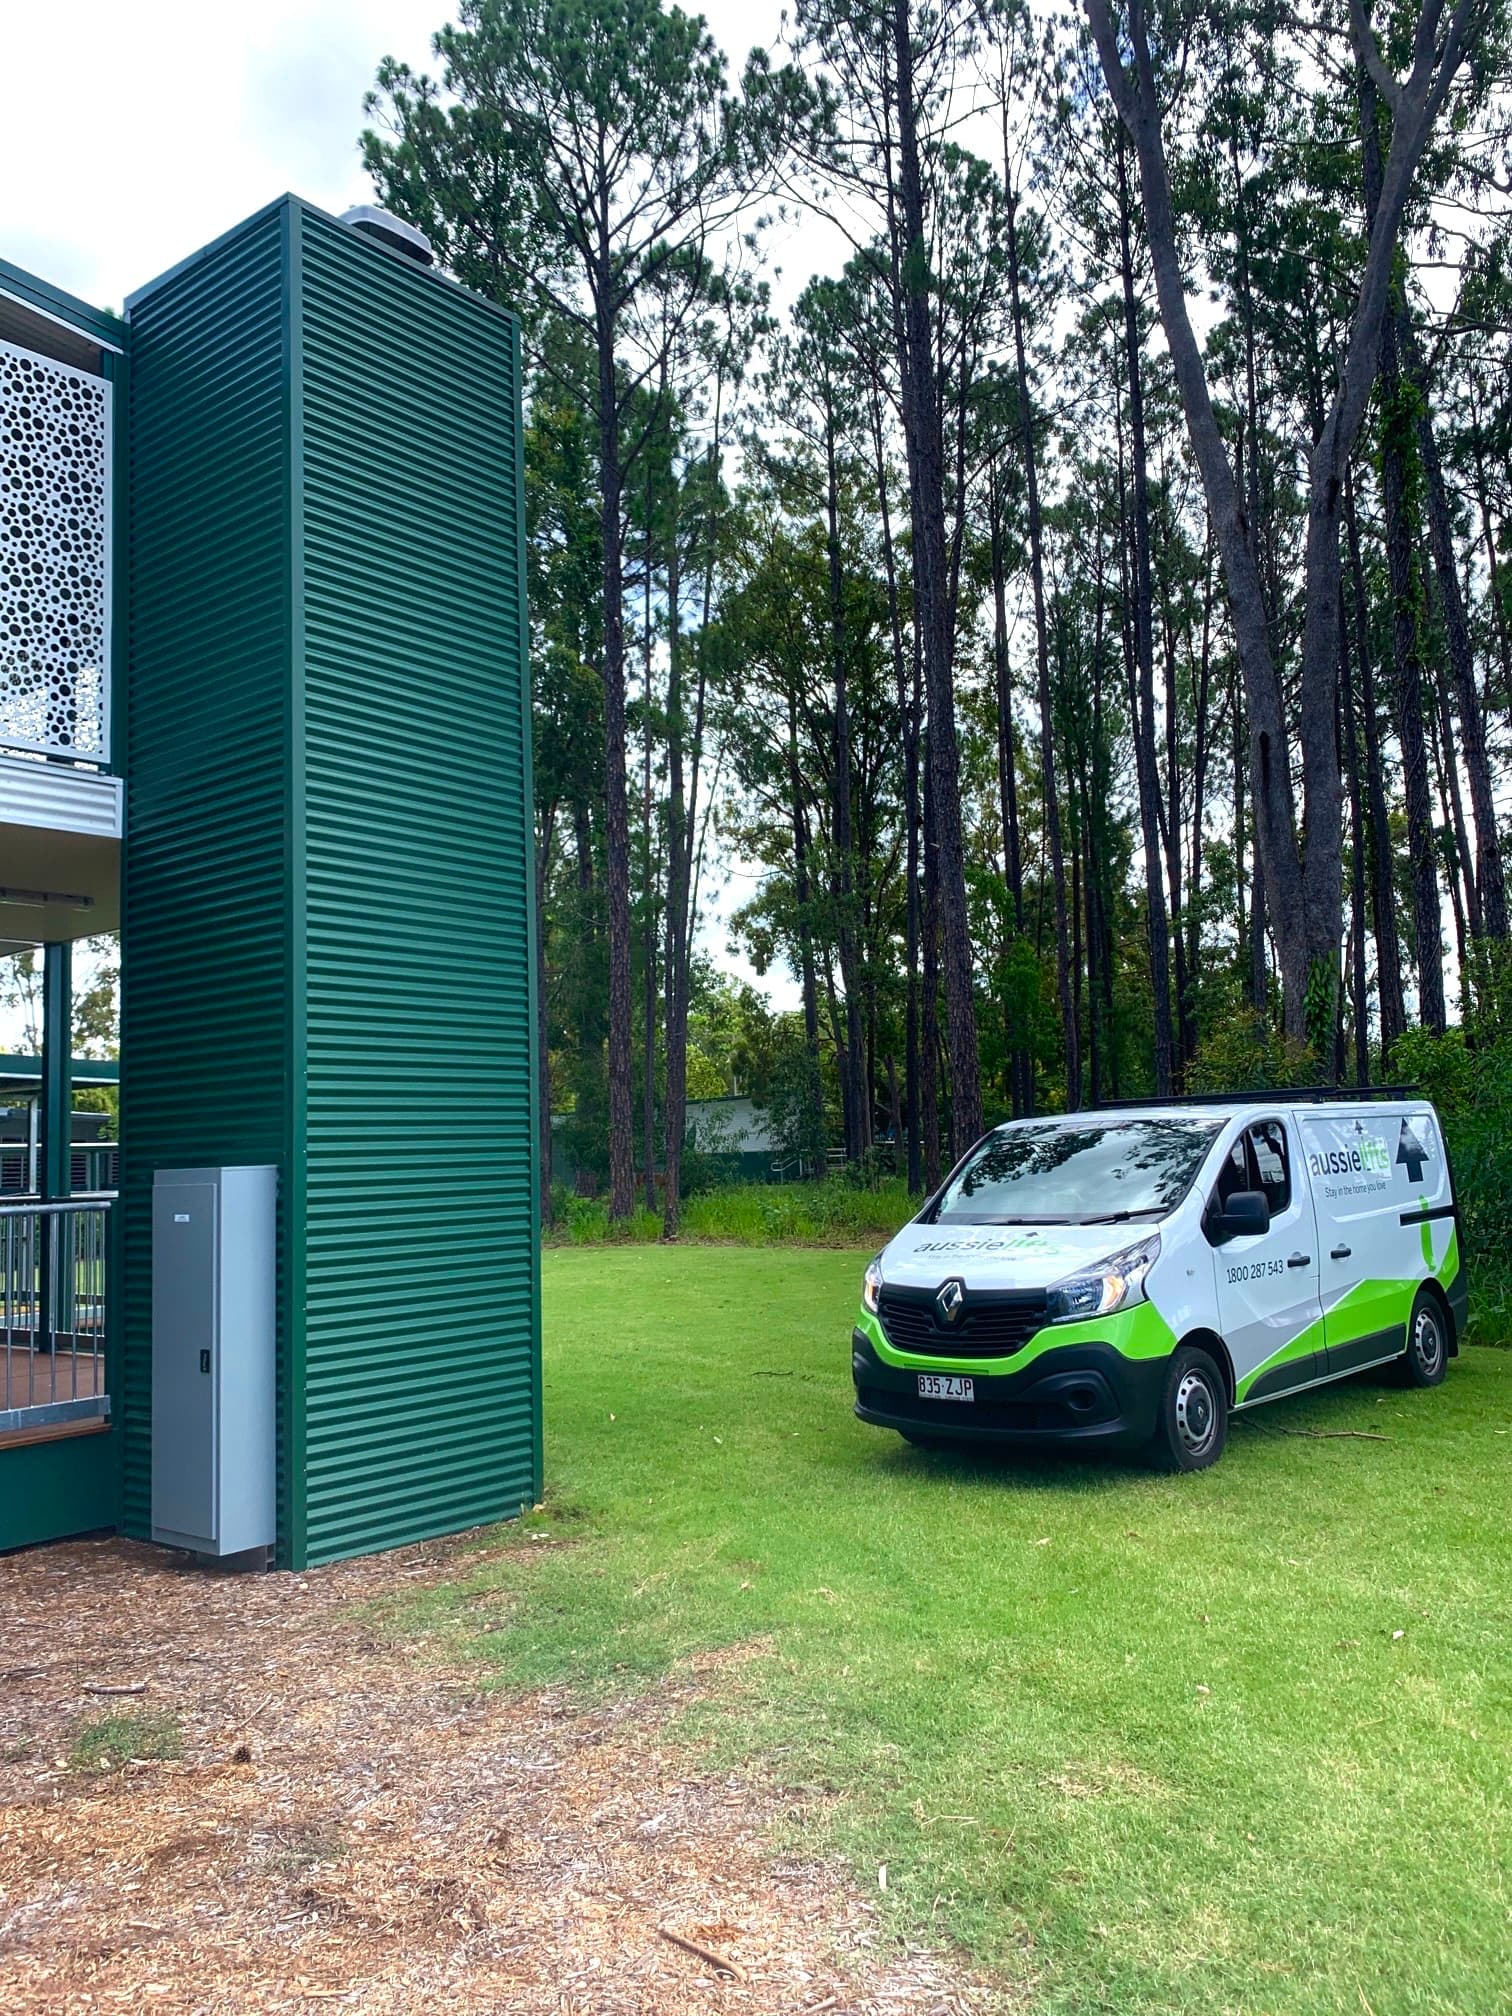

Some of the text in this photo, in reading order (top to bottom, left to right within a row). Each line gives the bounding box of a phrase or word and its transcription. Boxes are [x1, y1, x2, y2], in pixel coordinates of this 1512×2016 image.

[1325, 1187, 1337, 1199] Stay
[1343, 1184, 1352, 1195] the
[1352, 1182, 1367, 1194] home
[1366, 1182, 1376, 1195] you
[1376, 1180, 1386, 1191] love
[1227, 1260, 1283, 1283] 1800 287 543
